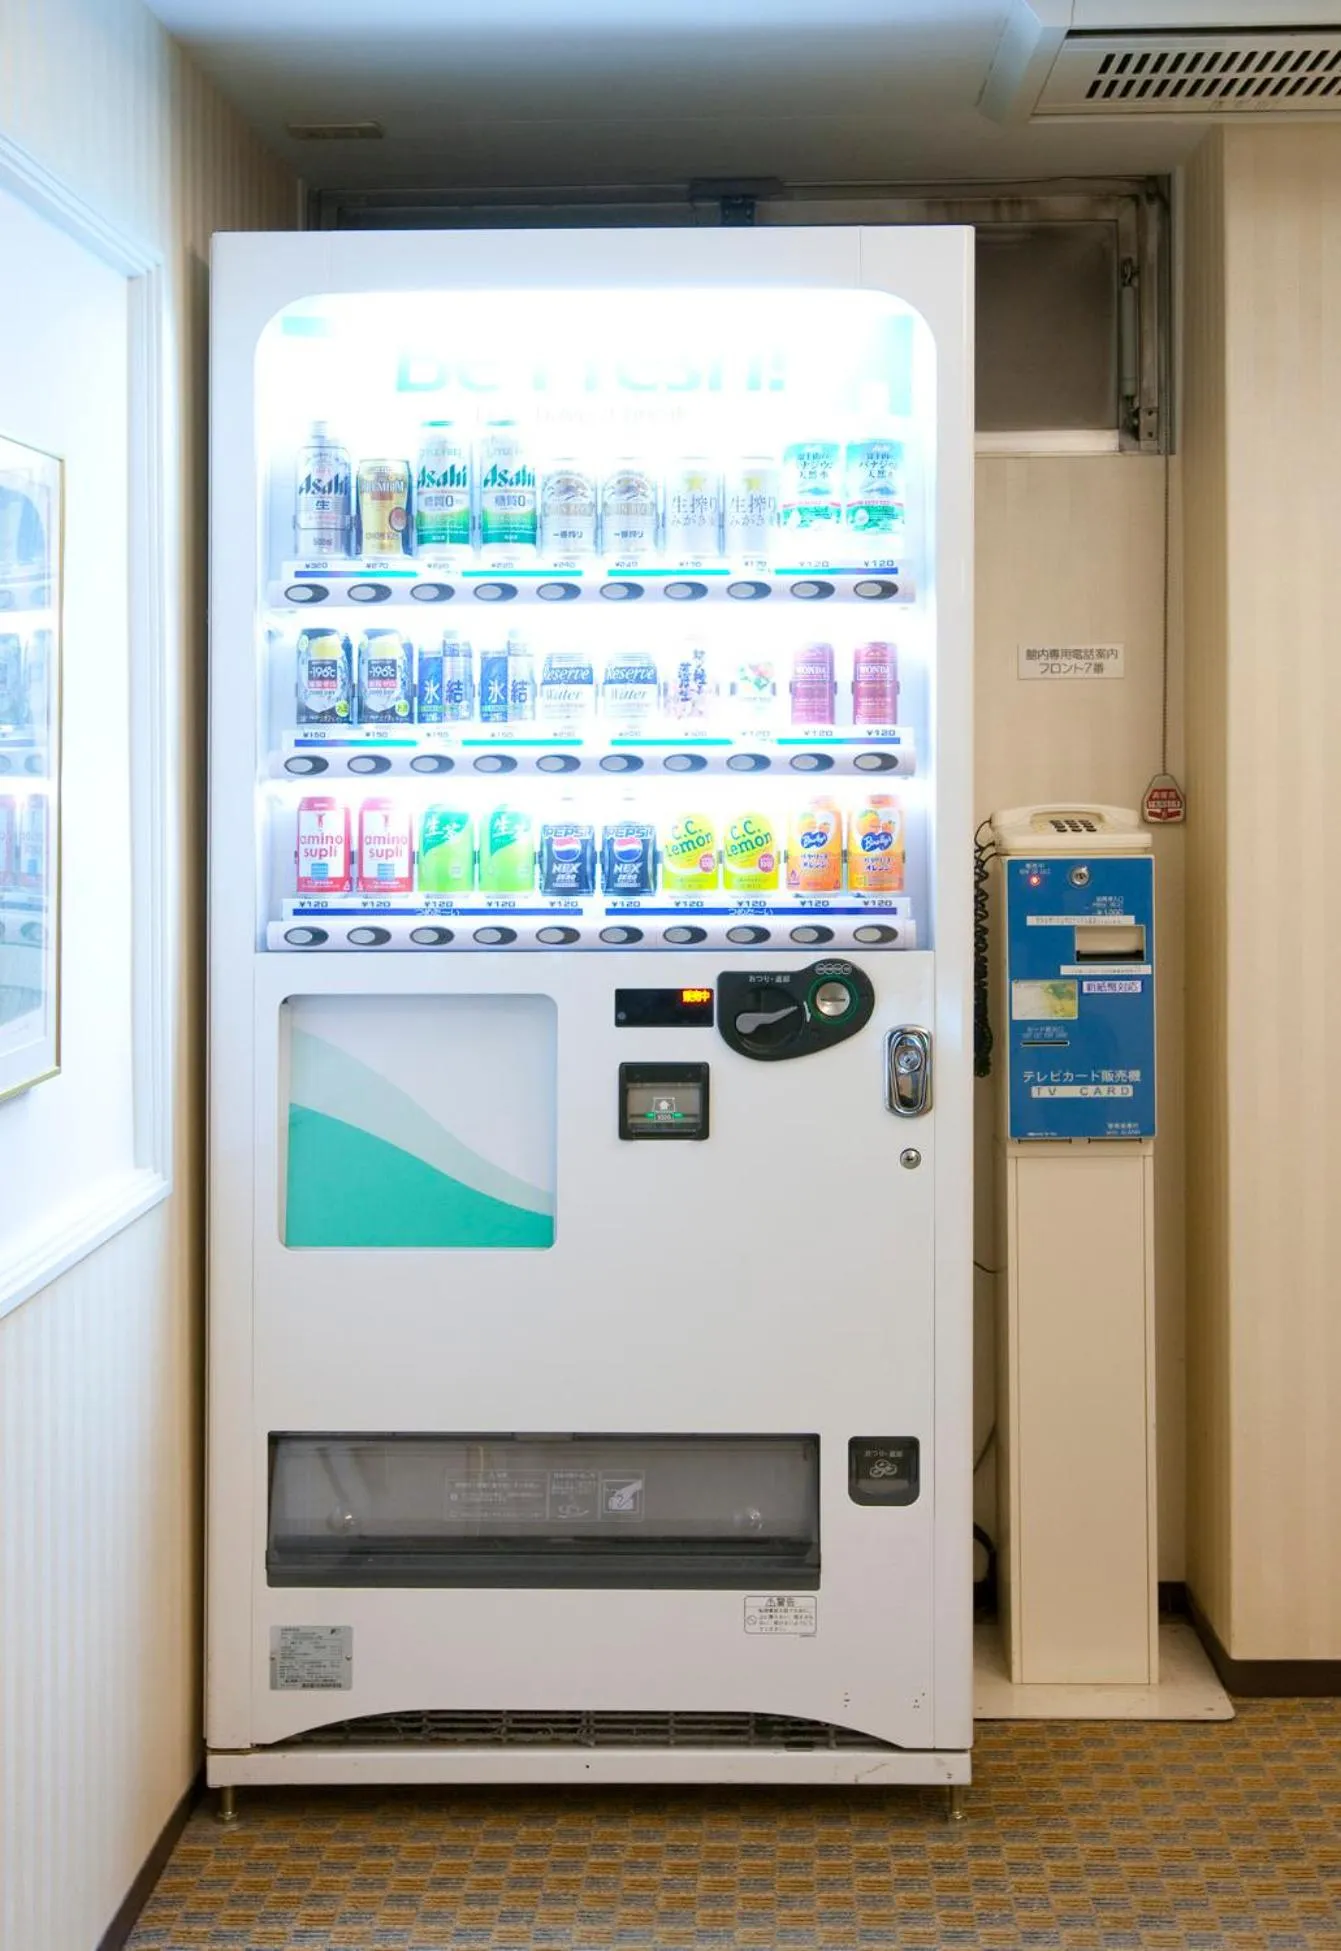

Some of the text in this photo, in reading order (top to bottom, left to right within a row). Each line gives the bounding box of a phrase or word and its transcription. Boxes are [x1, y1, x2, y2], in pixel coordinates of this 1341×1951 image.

[418, 463, 467, 489] Asahi
[483, 463, 536, 489] Asahi
[298, 472, 350, 496] Asahi
[315, 500, 331, 511] 生
[864, 559, 895, 567] ¥120
[1039, 662, 1103, 675] フロント7番
[425, 679, 463, 704] 氷結
[489, 679, 528, 704] 氷結
[867, 728, 896, 736] ¥120
[300, 832, 343, 845] amino
[365, 832, 408, 845] amino
[544, 828, 593, 839] PEPSI
[606, 828, 655, 839] PEPSI
[304, 845, 338, 860] supli
[369, 845, 403, 860] supli
[552, 863, 582, 874] NEX
[613, 863, 643, 874] NEX
[299, 900, 329, 908] ¥120
[361, 900, 391, 908] ¥120
[424, 900, 454, 908] ¥120
[486, 900, 516, 908] ¥120
[800, 899, 830, 907] ¥120
[863, 899, 893, 907] ¥120
[1023, 1070, 1141, 1083] テレビカード販売機
[1037, 1086, 1130, 1096] TV CARD
